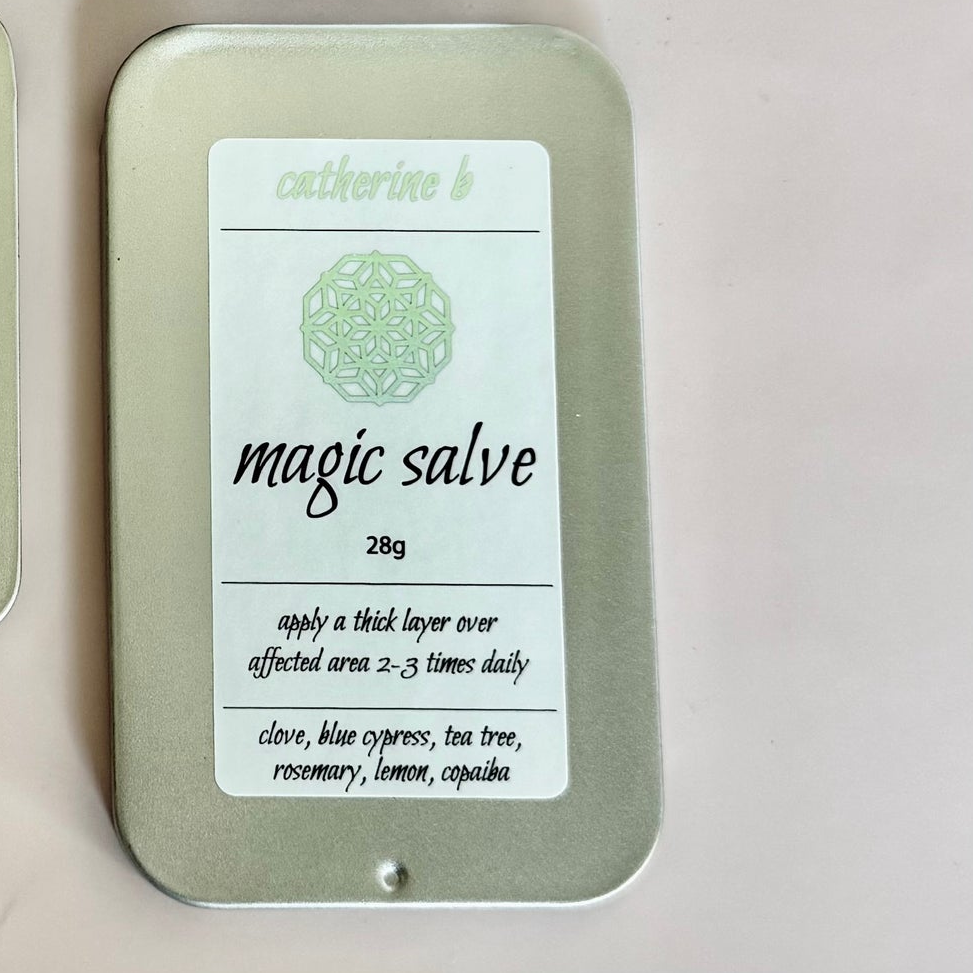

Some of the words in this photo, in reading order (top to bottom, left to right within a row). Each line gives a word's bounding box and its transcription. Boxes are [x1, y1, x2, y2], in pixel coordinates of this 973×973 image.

[275, 154, 440, 203] catherine
[449, 154, 474, 201] b
[232, 427, 385, 518] magic
[401, 421, 536, 486] salve
[366, 535, 405, 560] 28g
[277, 606, 329, 642] apply
[333, 615, 346, 631] a
[353, 606, 398, 633] thick
[401, 606, 451, 643] layer
[456, 615, 498, 633] over
[247, 645, 324, 679] affected
[327, 656, 370, 672] area
[376, 656, 418, 679] 2-3
[426, 651, 476, 674] times
[480, 648, 529, 685] daily
[258, 719, 310, 750] clove,
[317, 719, 357, 747] blue
[361, 727, 435, 757] cypress,
[444, 724, 472, 746] tea
[480, 725, 521, 752] tree,
[272, 762, 366, 792] rosemary,
[373, 755, 434, 786] lemon,
[440, 756, 510, 791] copaiba
